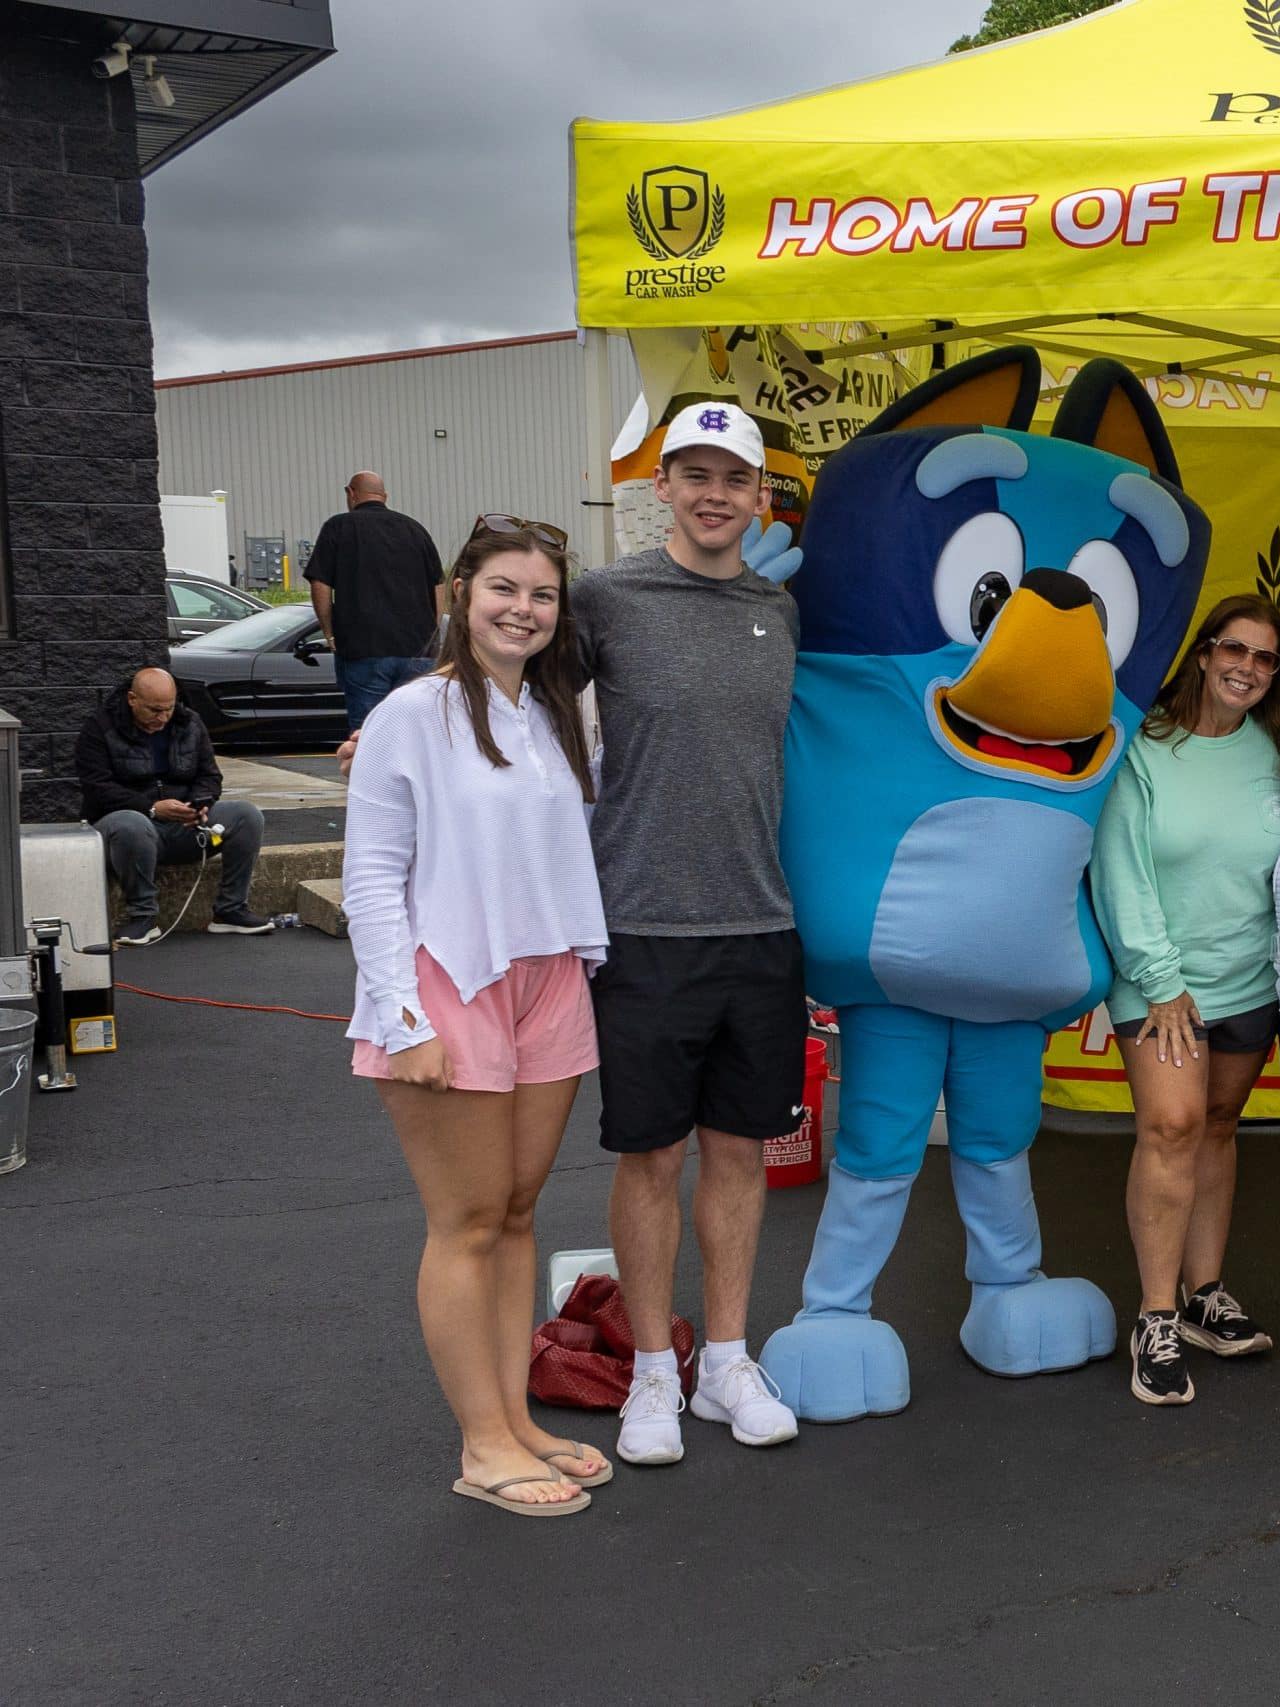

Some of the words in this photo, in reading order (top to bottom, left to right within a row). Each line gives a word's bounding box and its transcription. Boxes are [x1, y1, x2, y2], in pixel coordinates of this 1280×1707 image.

[656, 185, 698, 231] P
[757, 194, 1039, 260] HOME
[1050, 177, 1187, 250] OF
[624, 262, 726, 296] prestige
[635, 287, 660, 299] CAR
[662, 286, 697, 298] WASH
